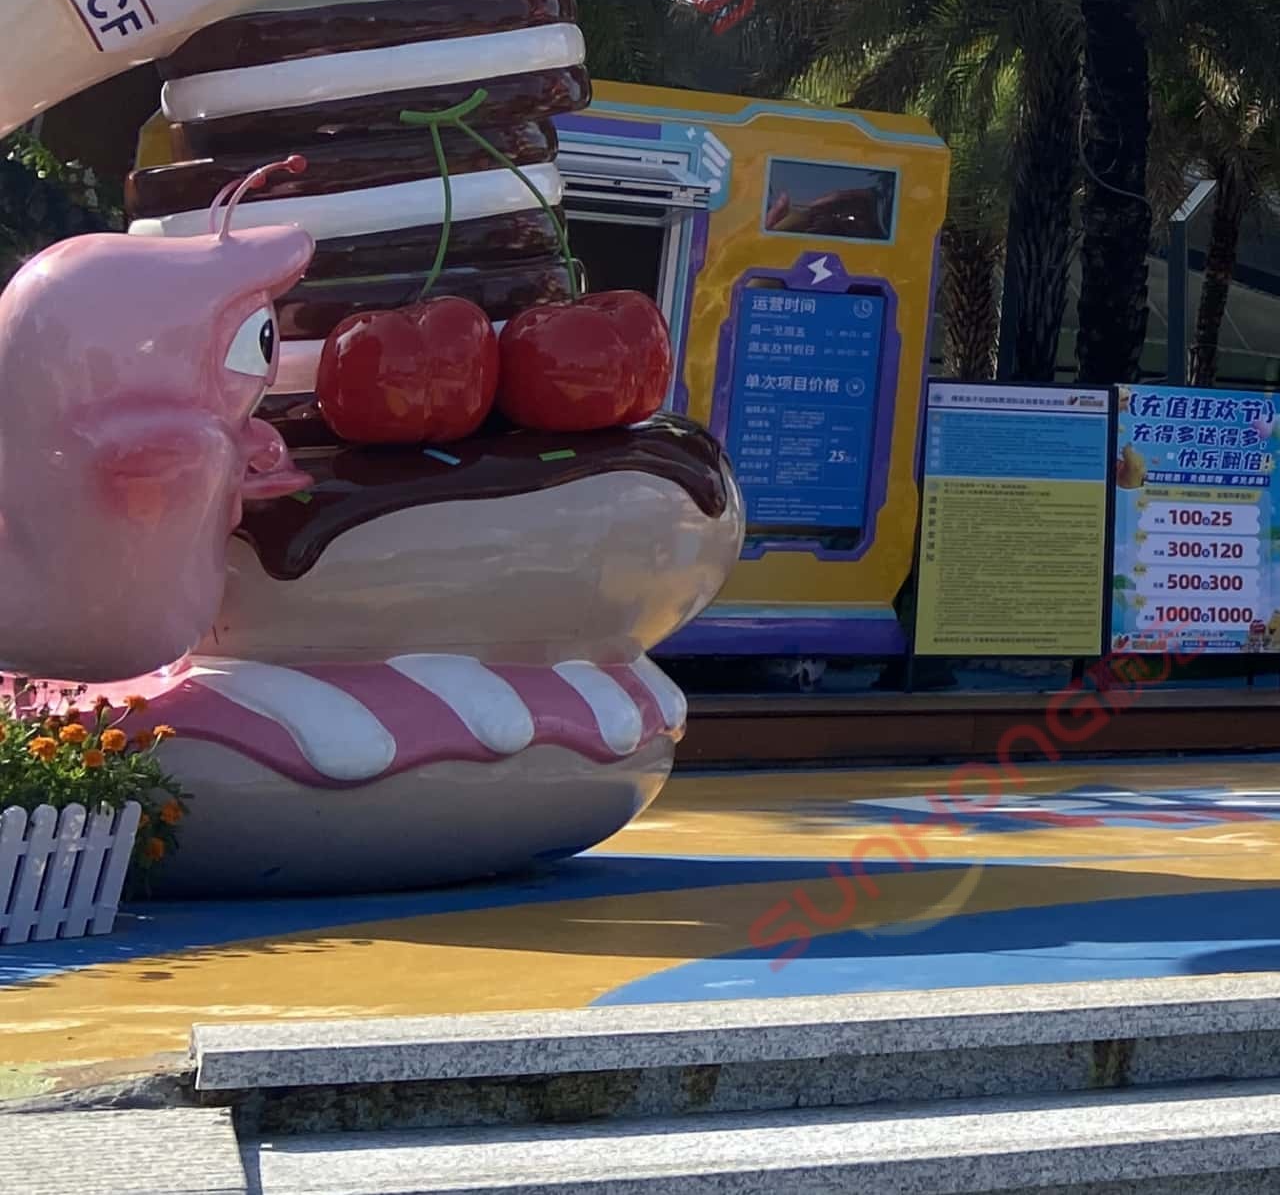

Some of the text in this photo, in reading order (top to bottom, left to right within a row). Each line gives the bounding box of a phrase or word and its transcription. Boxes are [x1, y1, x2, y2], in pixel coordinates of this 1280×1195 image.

[751, 295, 816, 314] 运营时间
[744, 374, 840, 394] 单次项目价格
[1168, 509, 1203, 526] 100
[1210, 511, 1233, 527] 25
[1167, 541, 1202, 558] 300
[1209, 543, 1243, 559] 120
[1167, 574, 1202, 590] 500
[1209, 575, 1243, 591] 300
[1155, 606, 1202, 623] 1000
[1208, 607, 1253, 623] 1000
